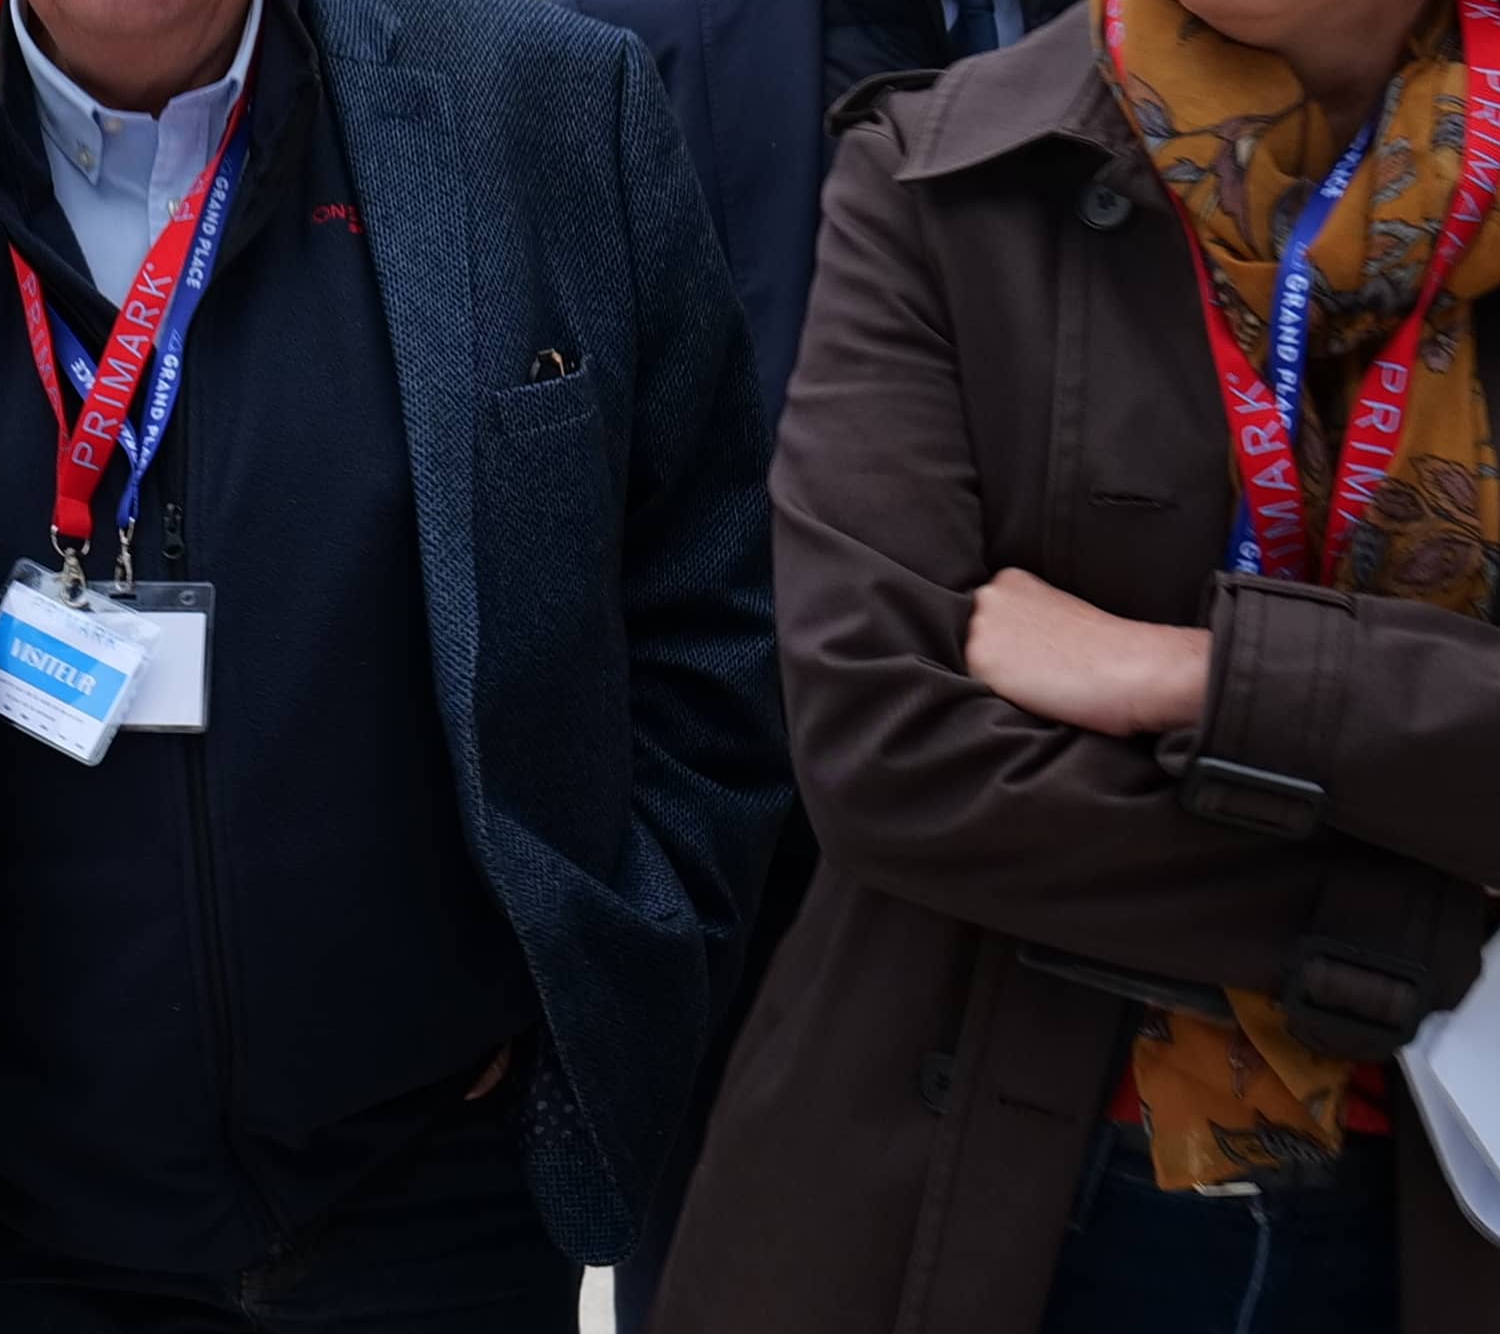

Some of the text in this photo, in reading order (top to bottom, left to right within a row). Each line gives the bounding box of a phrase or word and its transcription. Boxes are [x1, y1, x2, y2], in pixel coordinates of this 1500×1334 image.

[201, 175, 230, 235] GRAND
[185, 236, 213, 290] PLACE
[1274, 273, 1310, 363] GRAND
[72, 265, 173, 472] PRIMARK
[149, 353, 180, 421] GRAND
